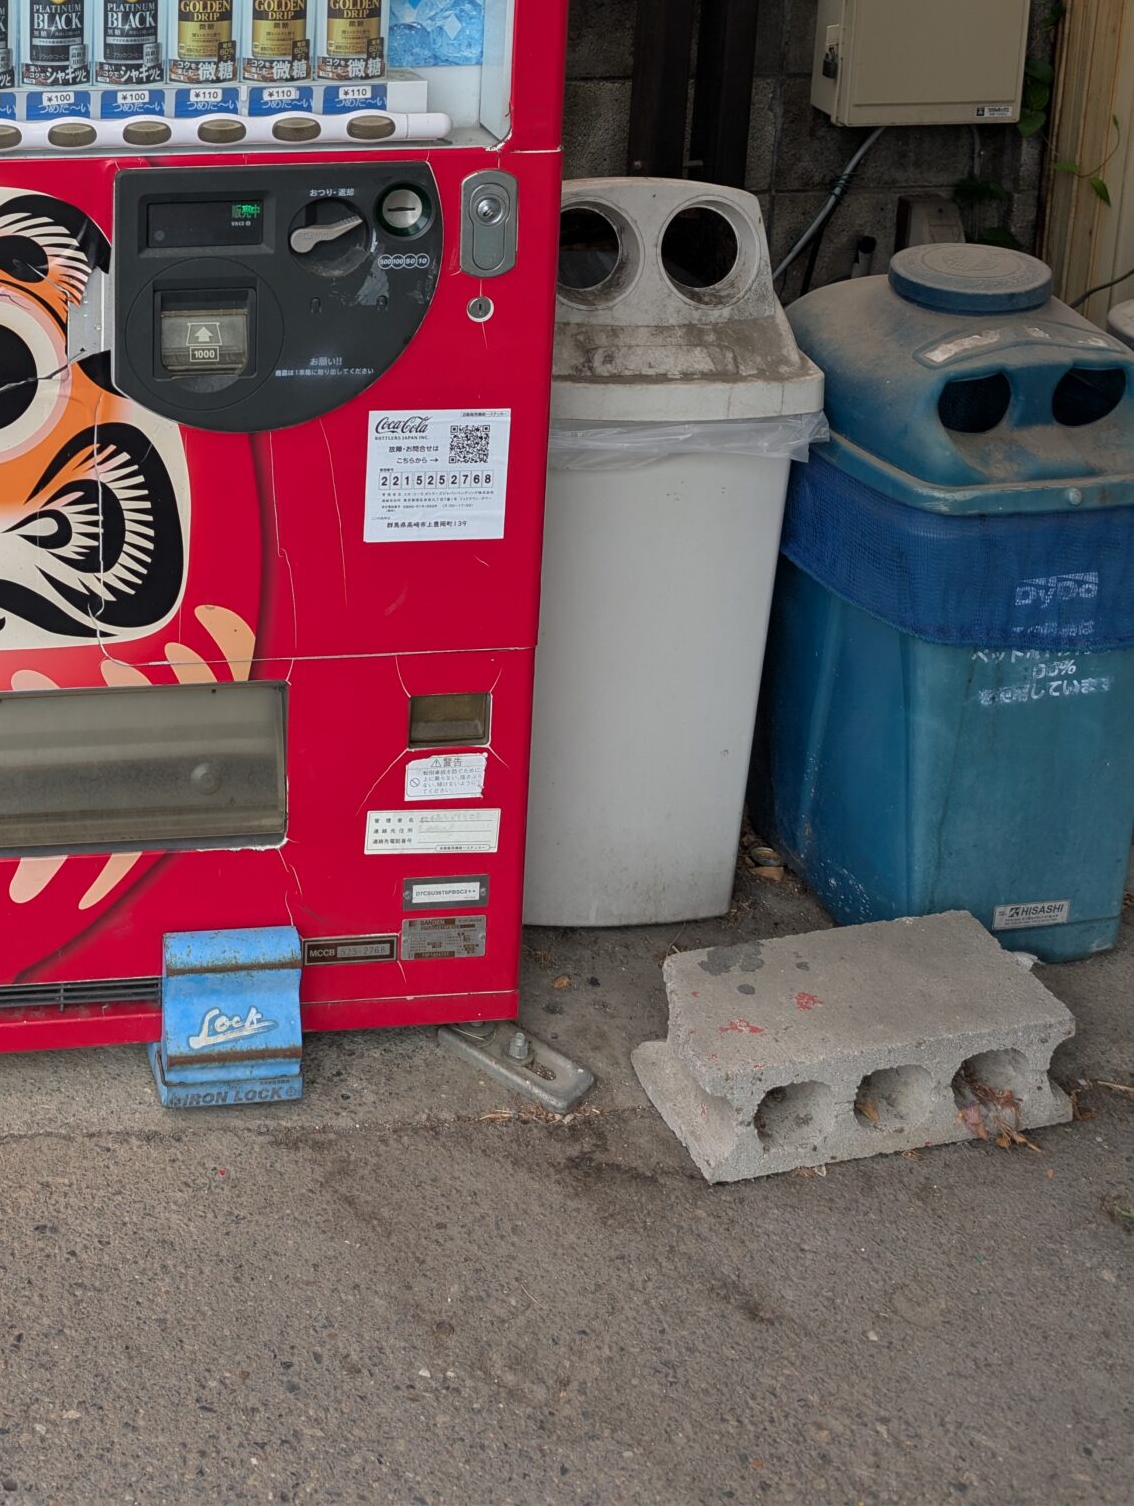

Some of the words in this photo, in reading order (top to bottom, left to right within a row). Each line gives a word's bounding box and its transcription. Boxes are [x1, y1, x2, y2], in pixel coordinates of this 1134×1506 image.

[33, 3, 81, 13] PLATINUM
[180, 0, 231, 13] GOLDEN
[194, 11, 220, 21] DRIP
[268, 10, 294, 20] DRIP
[198, 59, 234, 80] 微糖
[46, 94, 71, 103] ¥100
[309, 188, 355, 197] おつり・返却
[405, 257, 415, 265] 50
[194, 350, 215, 359] 1000
[375, 415, 430, 434] Coca-Cola
[389, 445, 439, 453] 故障・お問合せは
[1021, 903, 1064, 916] HISASHI
[310, 949, 336, 957] MCCB
[189, 1006, 268, 1049] Lock
[183, 1090, 229, 1107] IRON
[234, 1087, 283, 1102] LOCK
